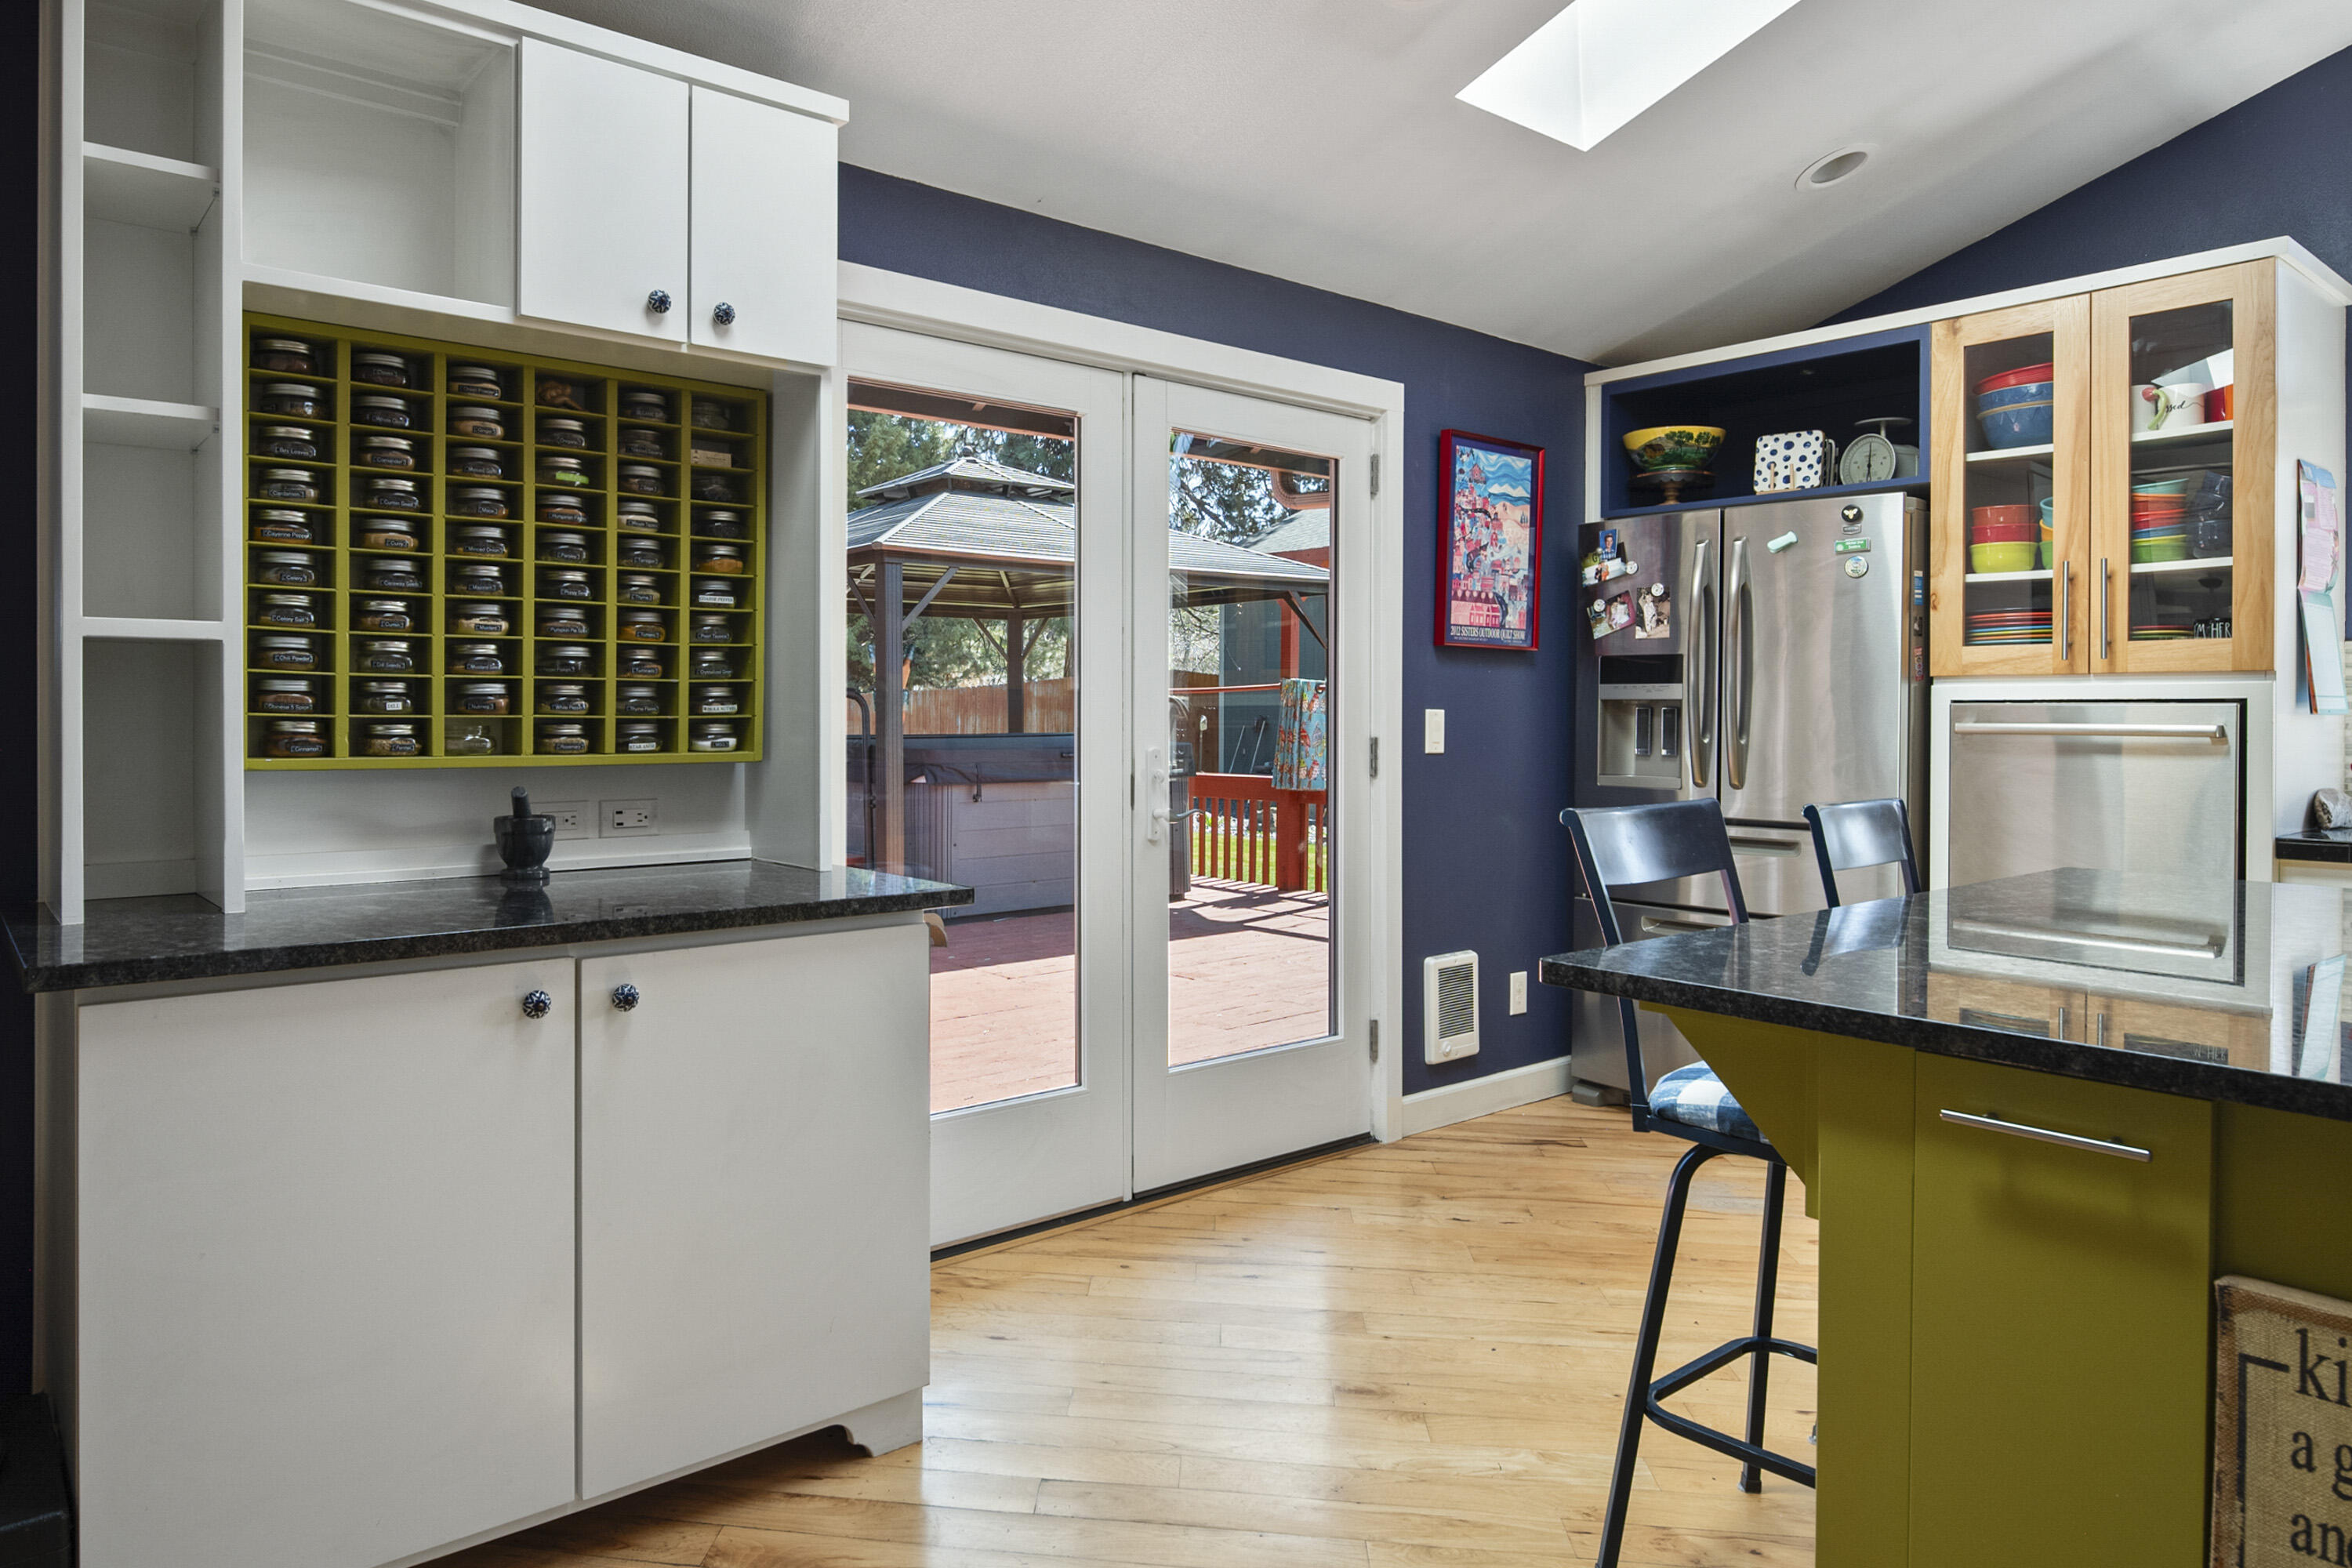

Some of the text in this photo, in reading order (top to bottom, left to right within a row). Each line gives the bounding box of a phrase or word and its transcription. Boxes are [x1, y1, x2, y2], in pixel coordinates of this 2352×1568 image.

[1461, 626, 1479, 637] SISTERS
[1479, 627, 1500, 639] OUTDOOR
[1500, 629, 1512, 641] QUILT
[1512, 630, 1526, 641] SHOW
[2291, 1432, 2317, 1472] a
[2290, 1514, 2352, 1568] an
